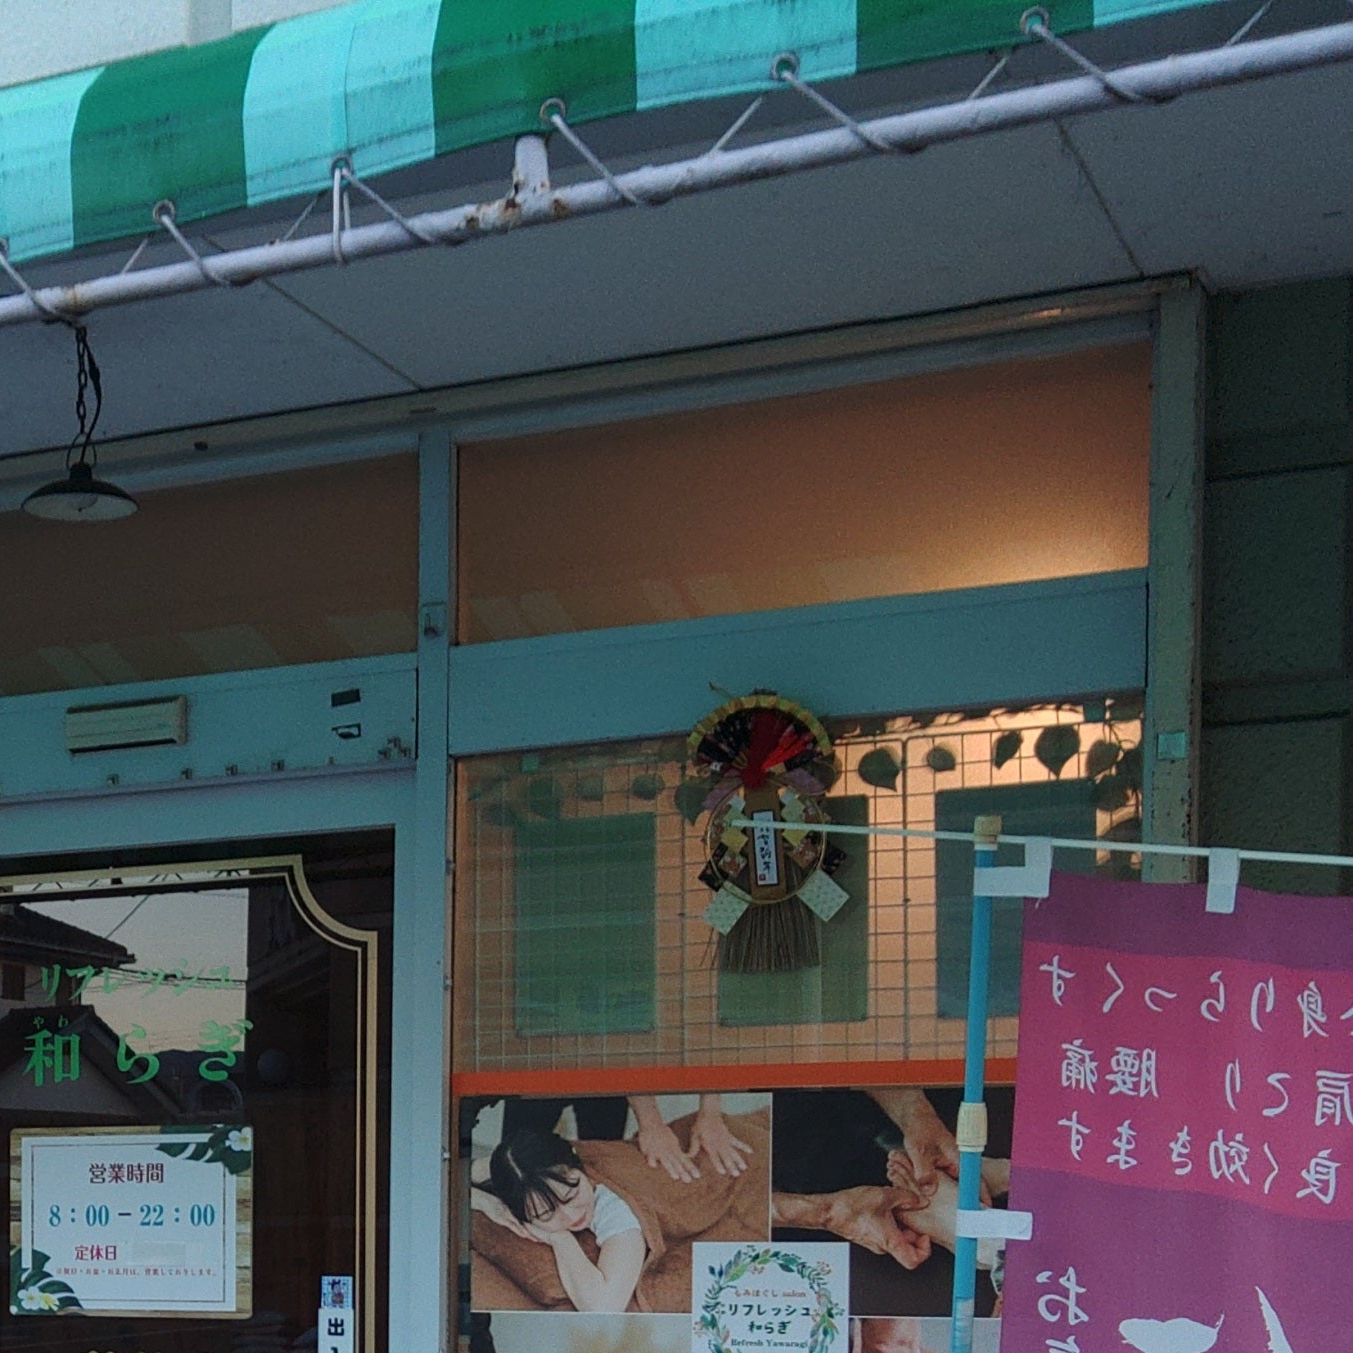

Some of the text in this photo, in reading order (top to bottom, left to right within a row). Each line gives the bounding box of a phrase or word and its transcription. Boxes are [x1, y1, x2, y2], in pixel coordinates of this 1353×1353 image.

[23, 1019, 253, 1086] 和らぎ
[89, 1163, 164, 1184] 営業時間
[75, 1245, 117, 1261] 定休日
[729, 1304, 811, 1316] リフレッシュ
